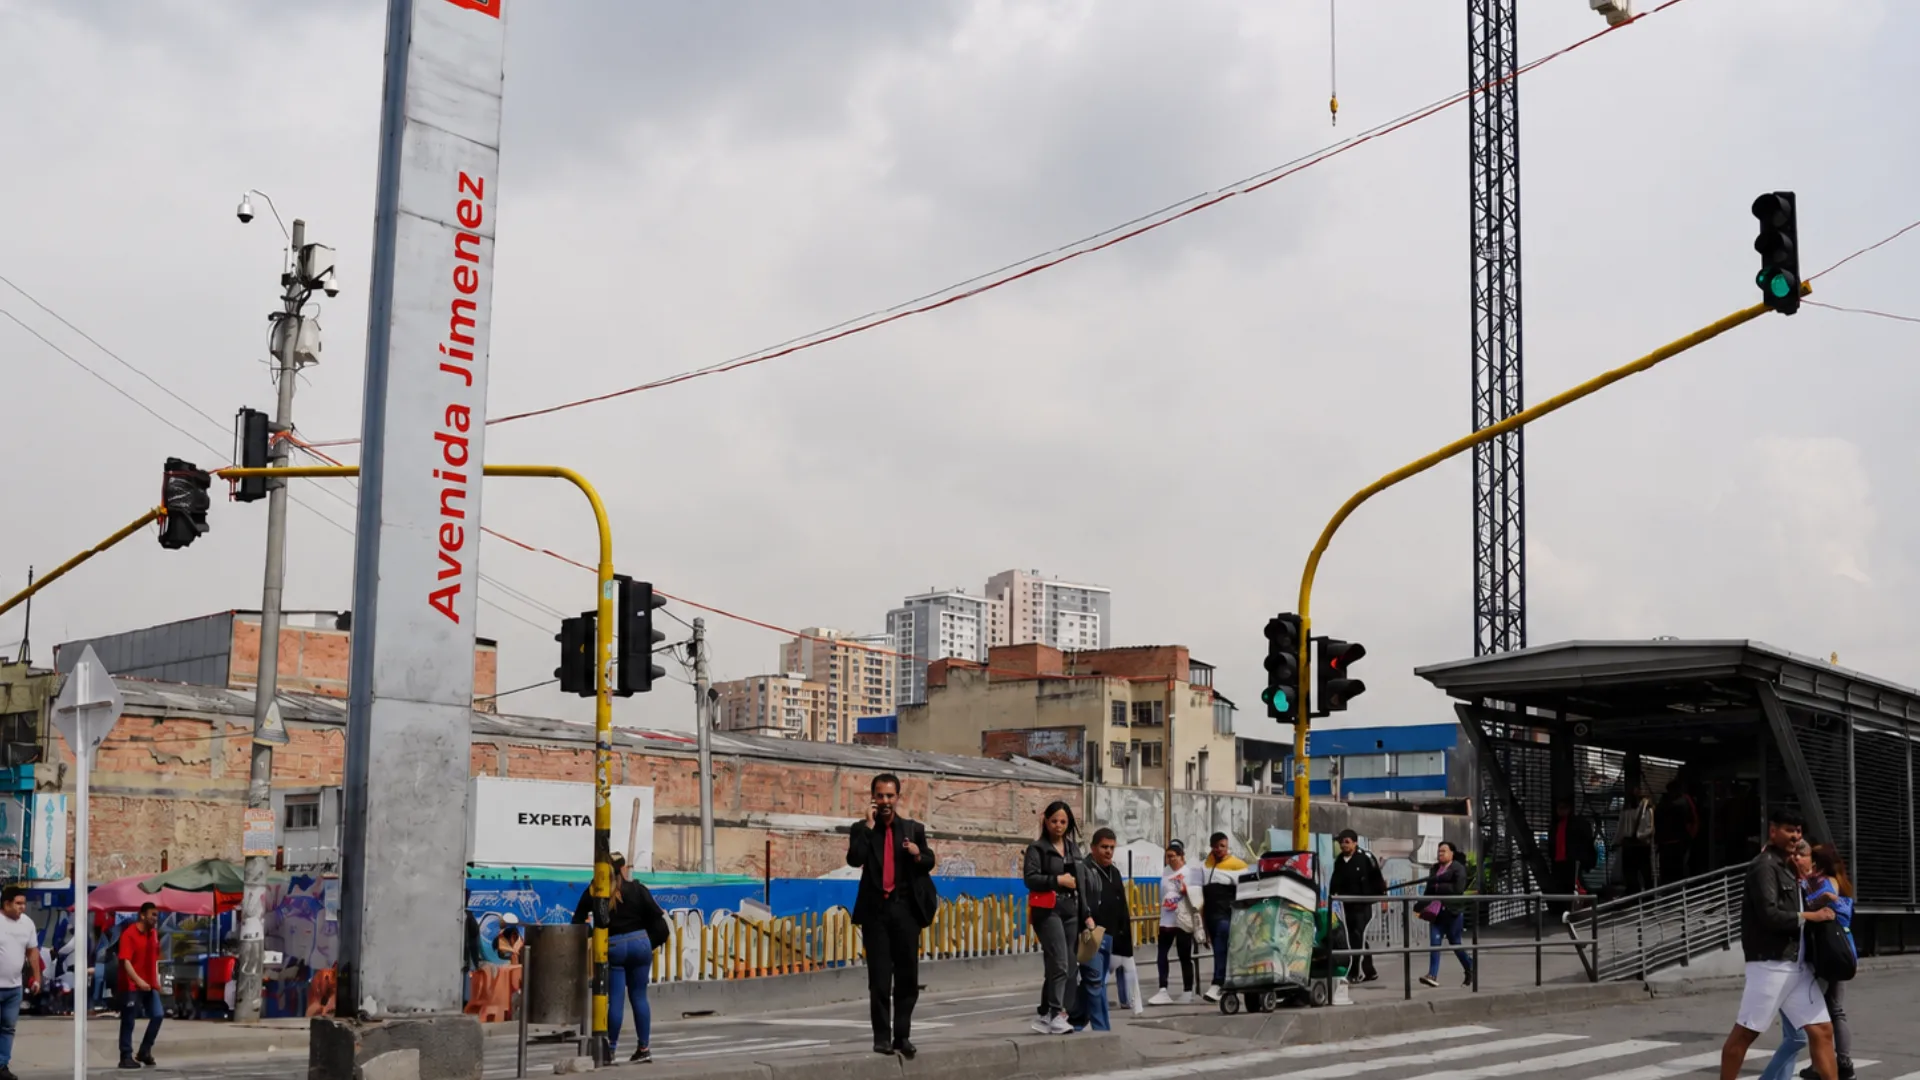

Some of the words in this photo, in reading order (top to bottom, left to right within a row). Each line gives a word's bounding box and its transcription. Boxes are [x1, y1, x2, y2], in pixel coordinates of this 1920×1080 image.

[439, 172, 485, 387] Jímenez
[429, 404, 471, 625] Avenida
[518, 812, 592, 827] EXPERTA
